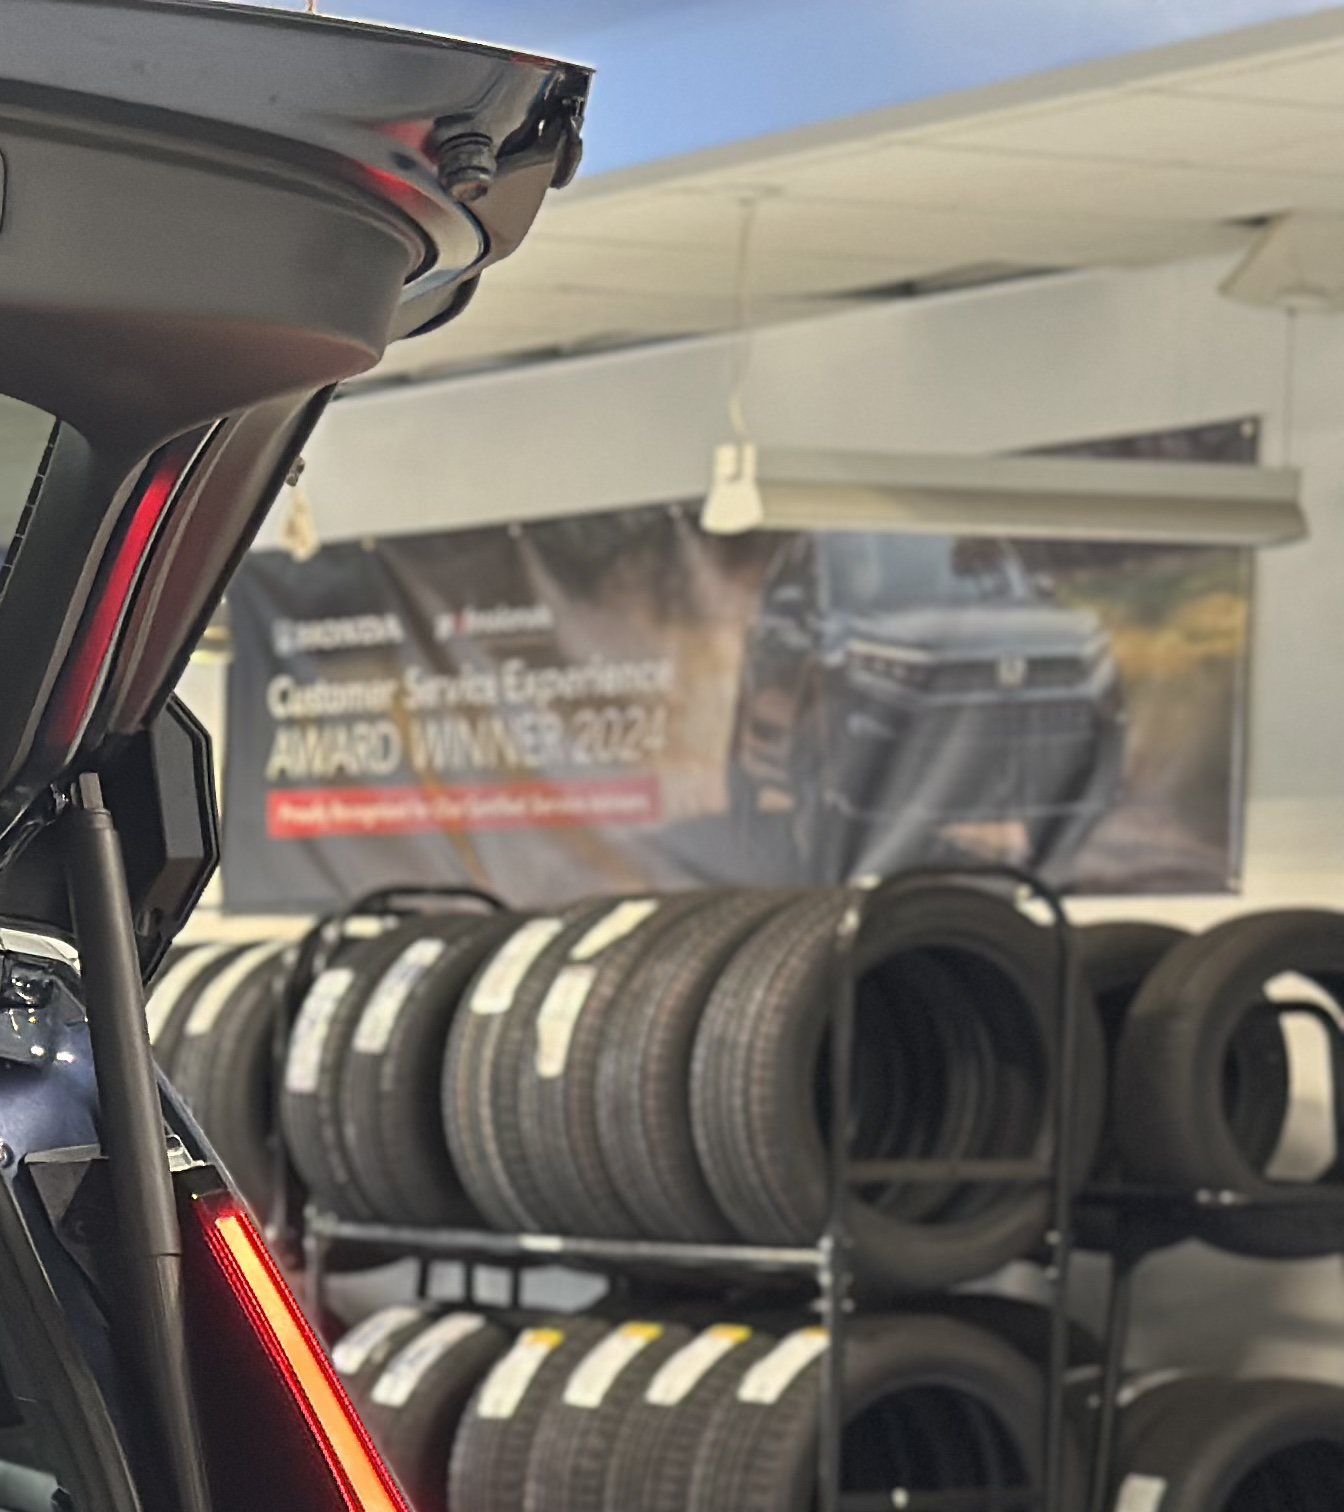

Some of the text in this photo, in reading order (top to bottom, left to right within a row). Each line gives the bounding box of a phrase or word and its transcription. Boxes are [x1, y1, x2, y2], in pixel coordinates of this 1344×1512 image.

[267, 654, 674, 719] Customer Service Experience
[265, 704, 667, 781] AWARD WINNER 2024
